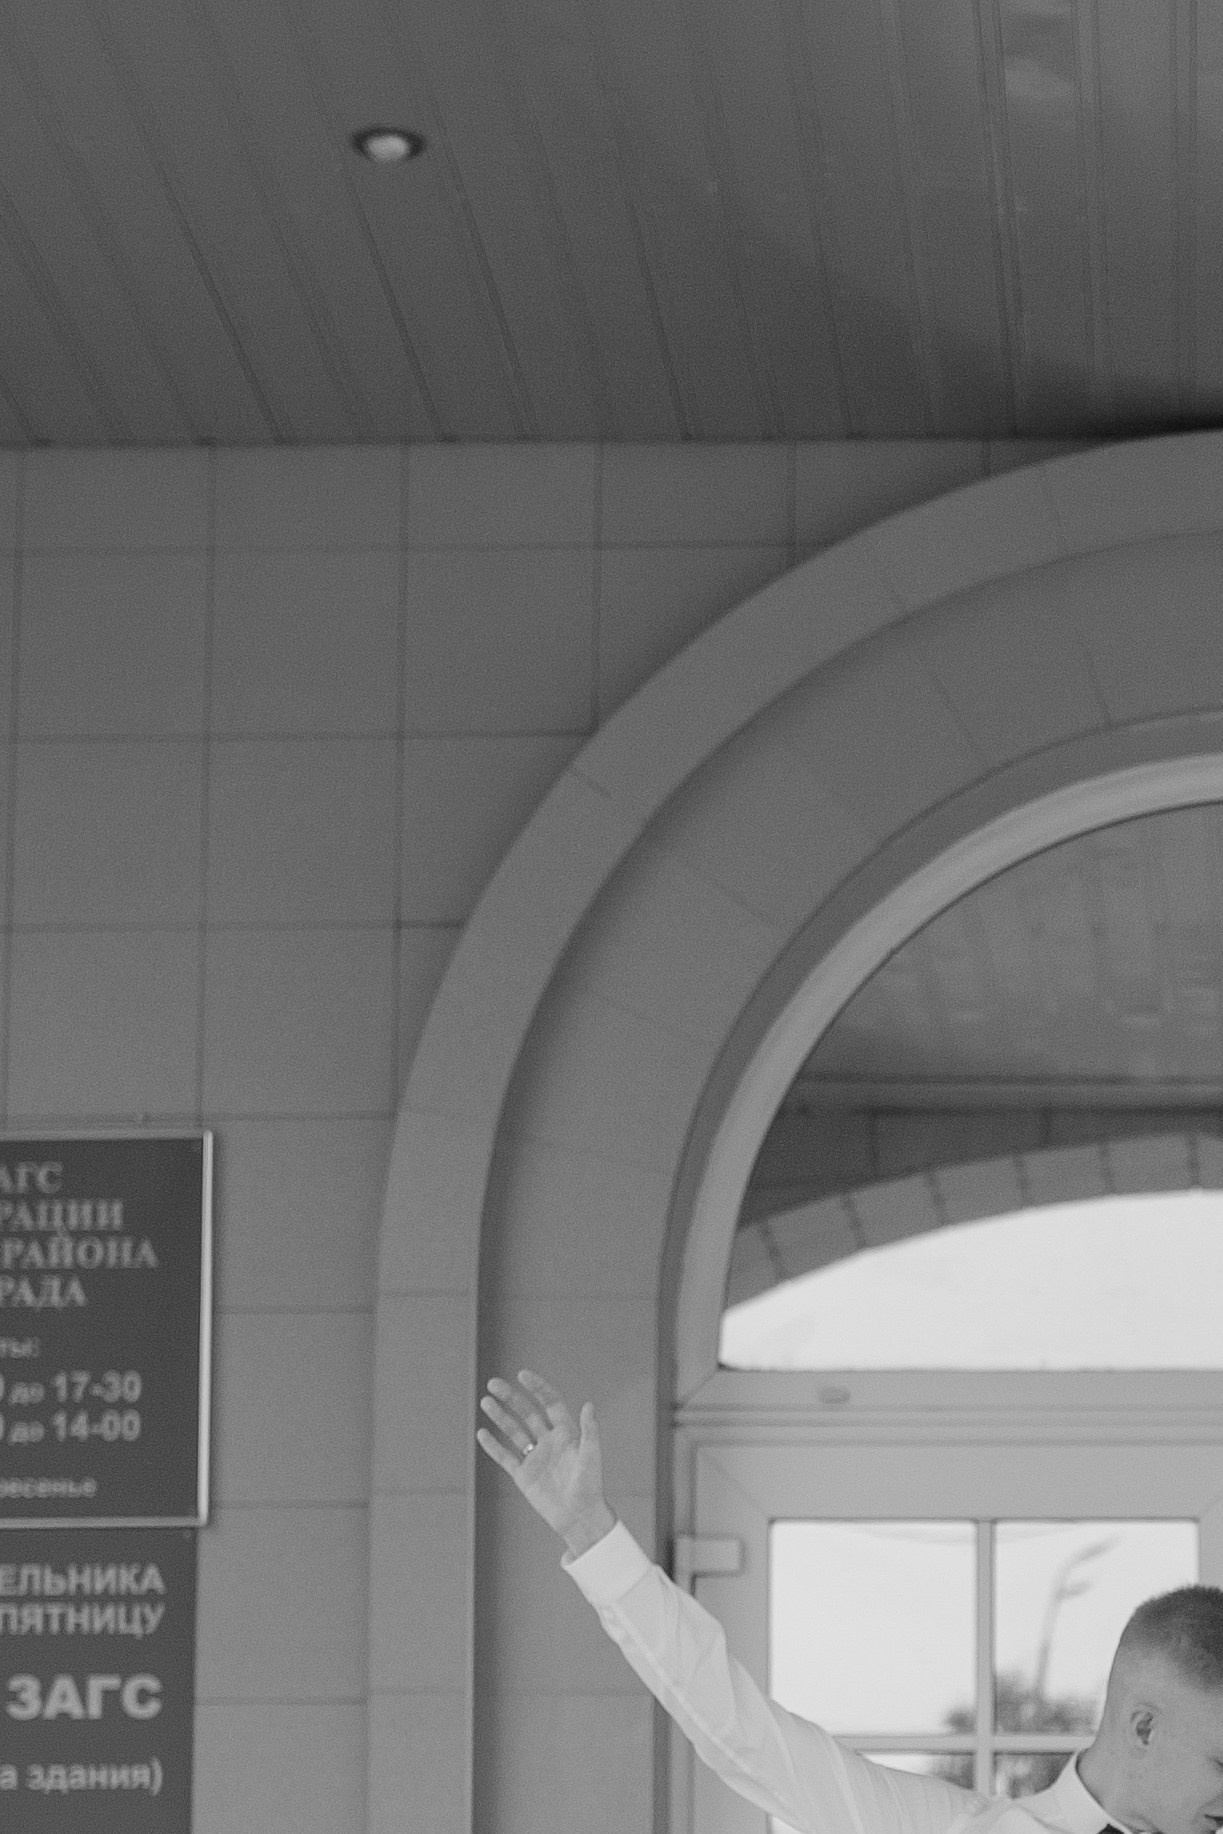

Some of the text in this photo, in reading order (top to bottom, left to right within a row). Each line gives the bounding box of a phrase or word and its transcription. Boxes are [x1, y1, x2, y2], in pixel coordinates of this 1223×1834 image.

[2, 1228, 158, 1269] РАЙОНА
[8, 1382, 45, 1406] до
[7, 1421, 45, 1446] до
[0, 1563, 166, 1596] ЕЛЬНИКА
[0, 1602, 165, 1638] ПЯТНИЦУ
[6, 1673, 163, 1720] ЗАГС
[26, 1757, 163, 1796] здания)
